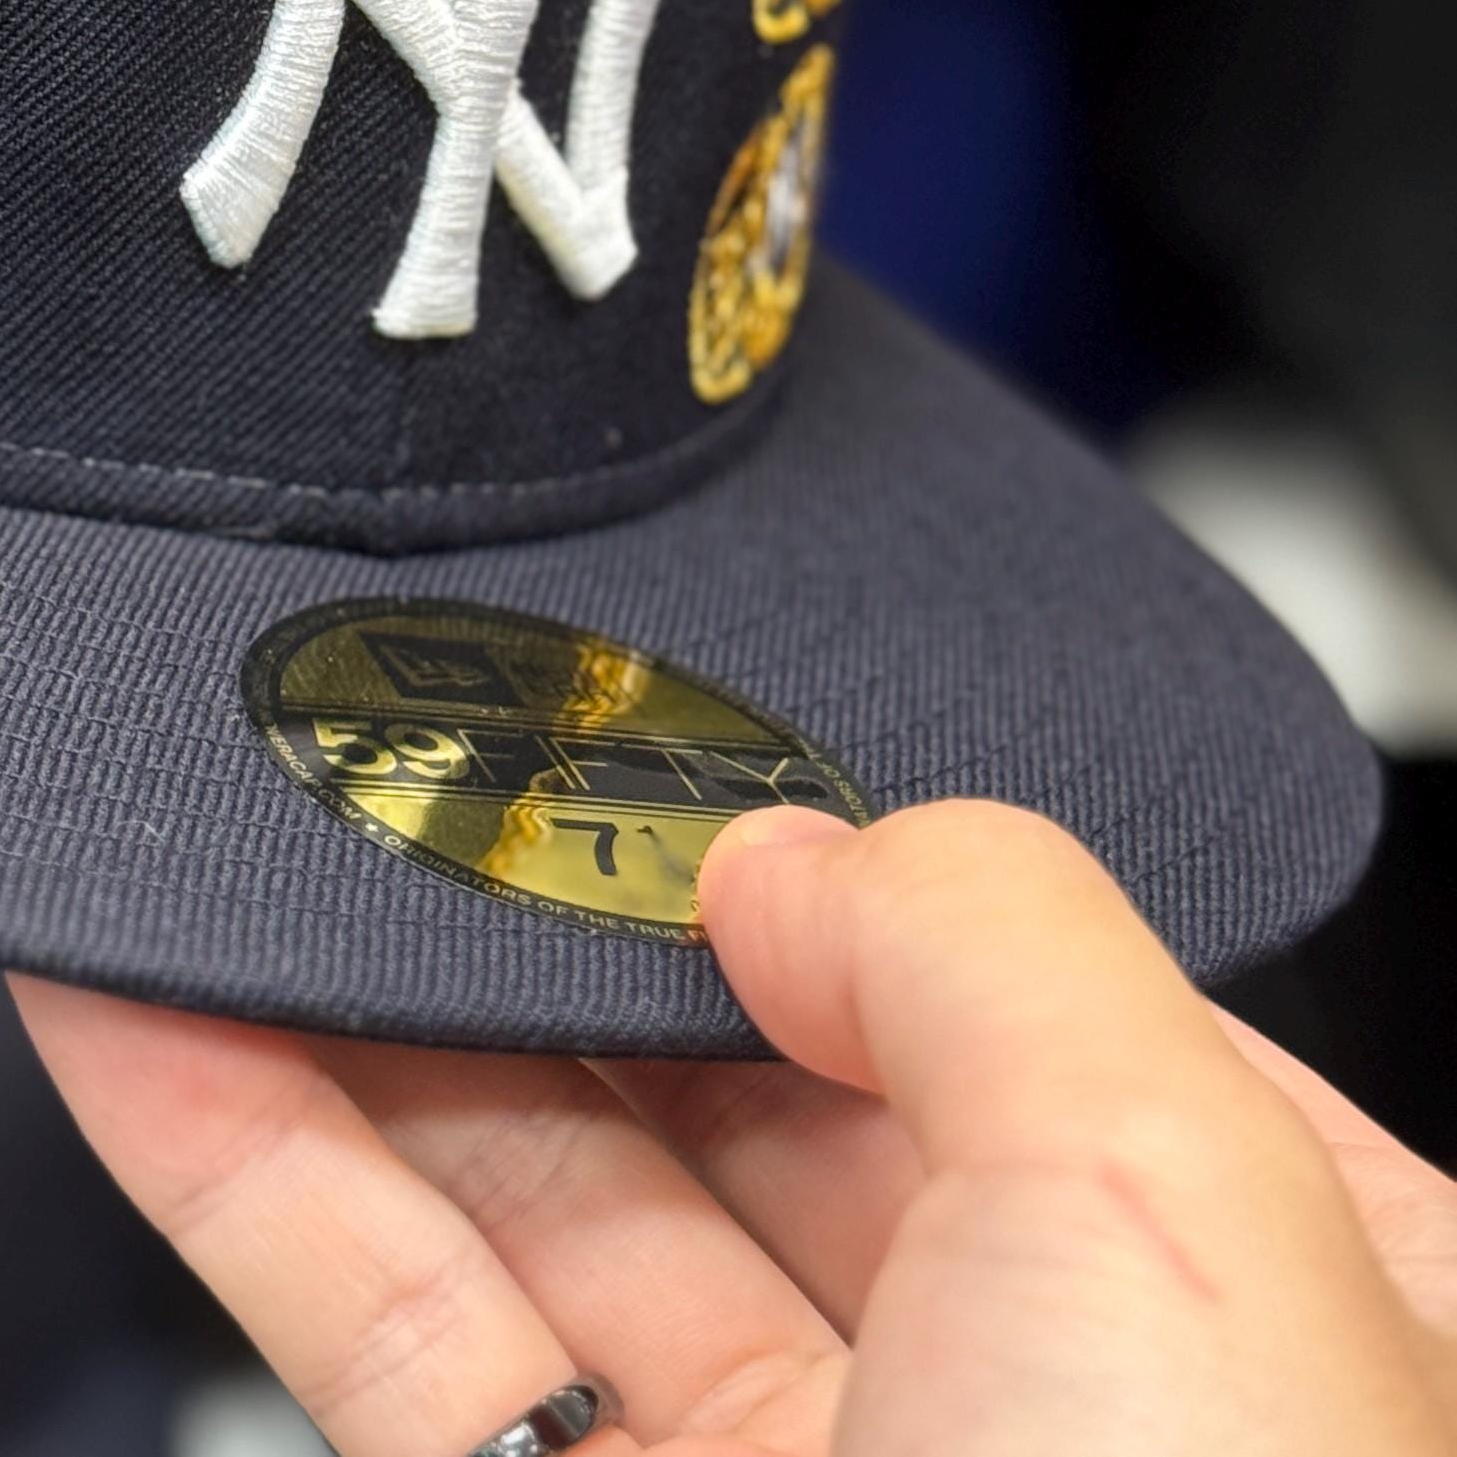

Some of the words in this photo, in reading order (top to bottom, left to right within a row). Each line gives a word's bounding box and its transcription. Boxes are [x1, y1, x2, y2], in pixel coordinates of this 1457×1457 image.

[384, 834, 532, 907] ORIGINATORS
[537, 901, 568, 917] OF
[575, 910, 621, 931] THE
[626, 922, 687, 941] TRUE
[550, 817, 619, 876] 7
